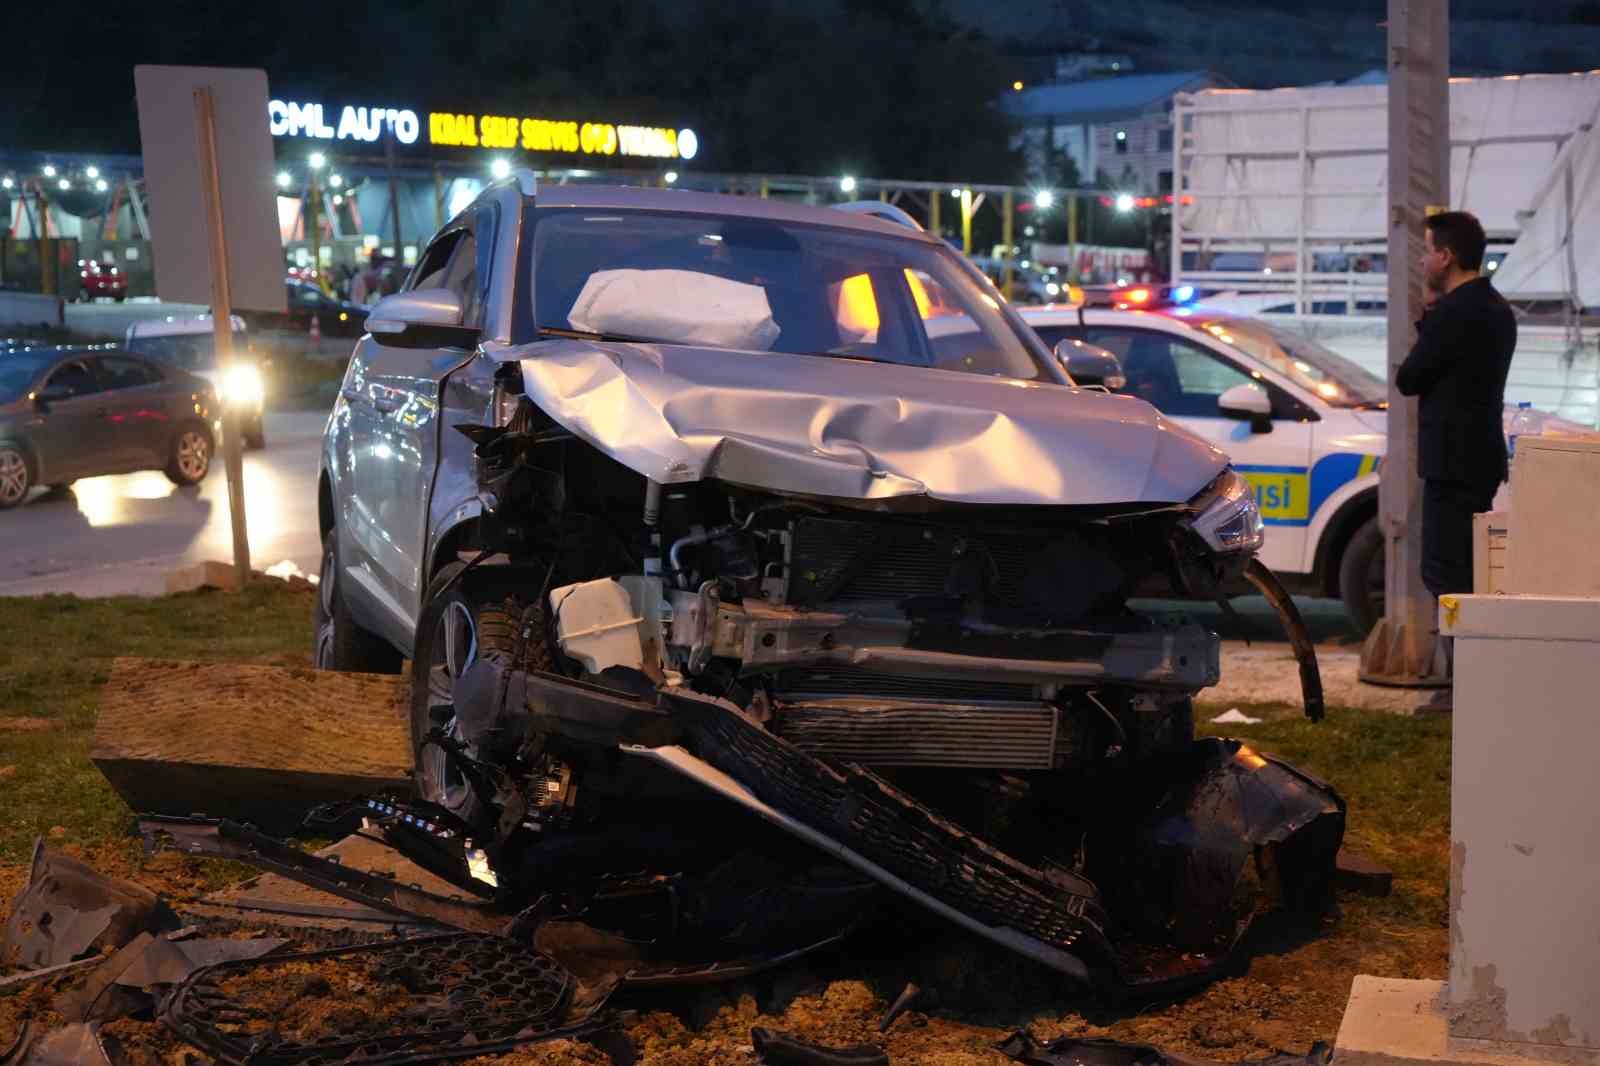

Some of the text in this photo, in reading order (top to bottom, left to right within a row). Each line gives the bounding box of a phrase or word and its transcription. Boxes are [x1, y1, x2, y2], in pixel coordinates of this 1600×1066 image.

[268, 100, 334, 138] CML
[480, 115, 519, 148] SELF
[580, 122, 617, 155] OTO
